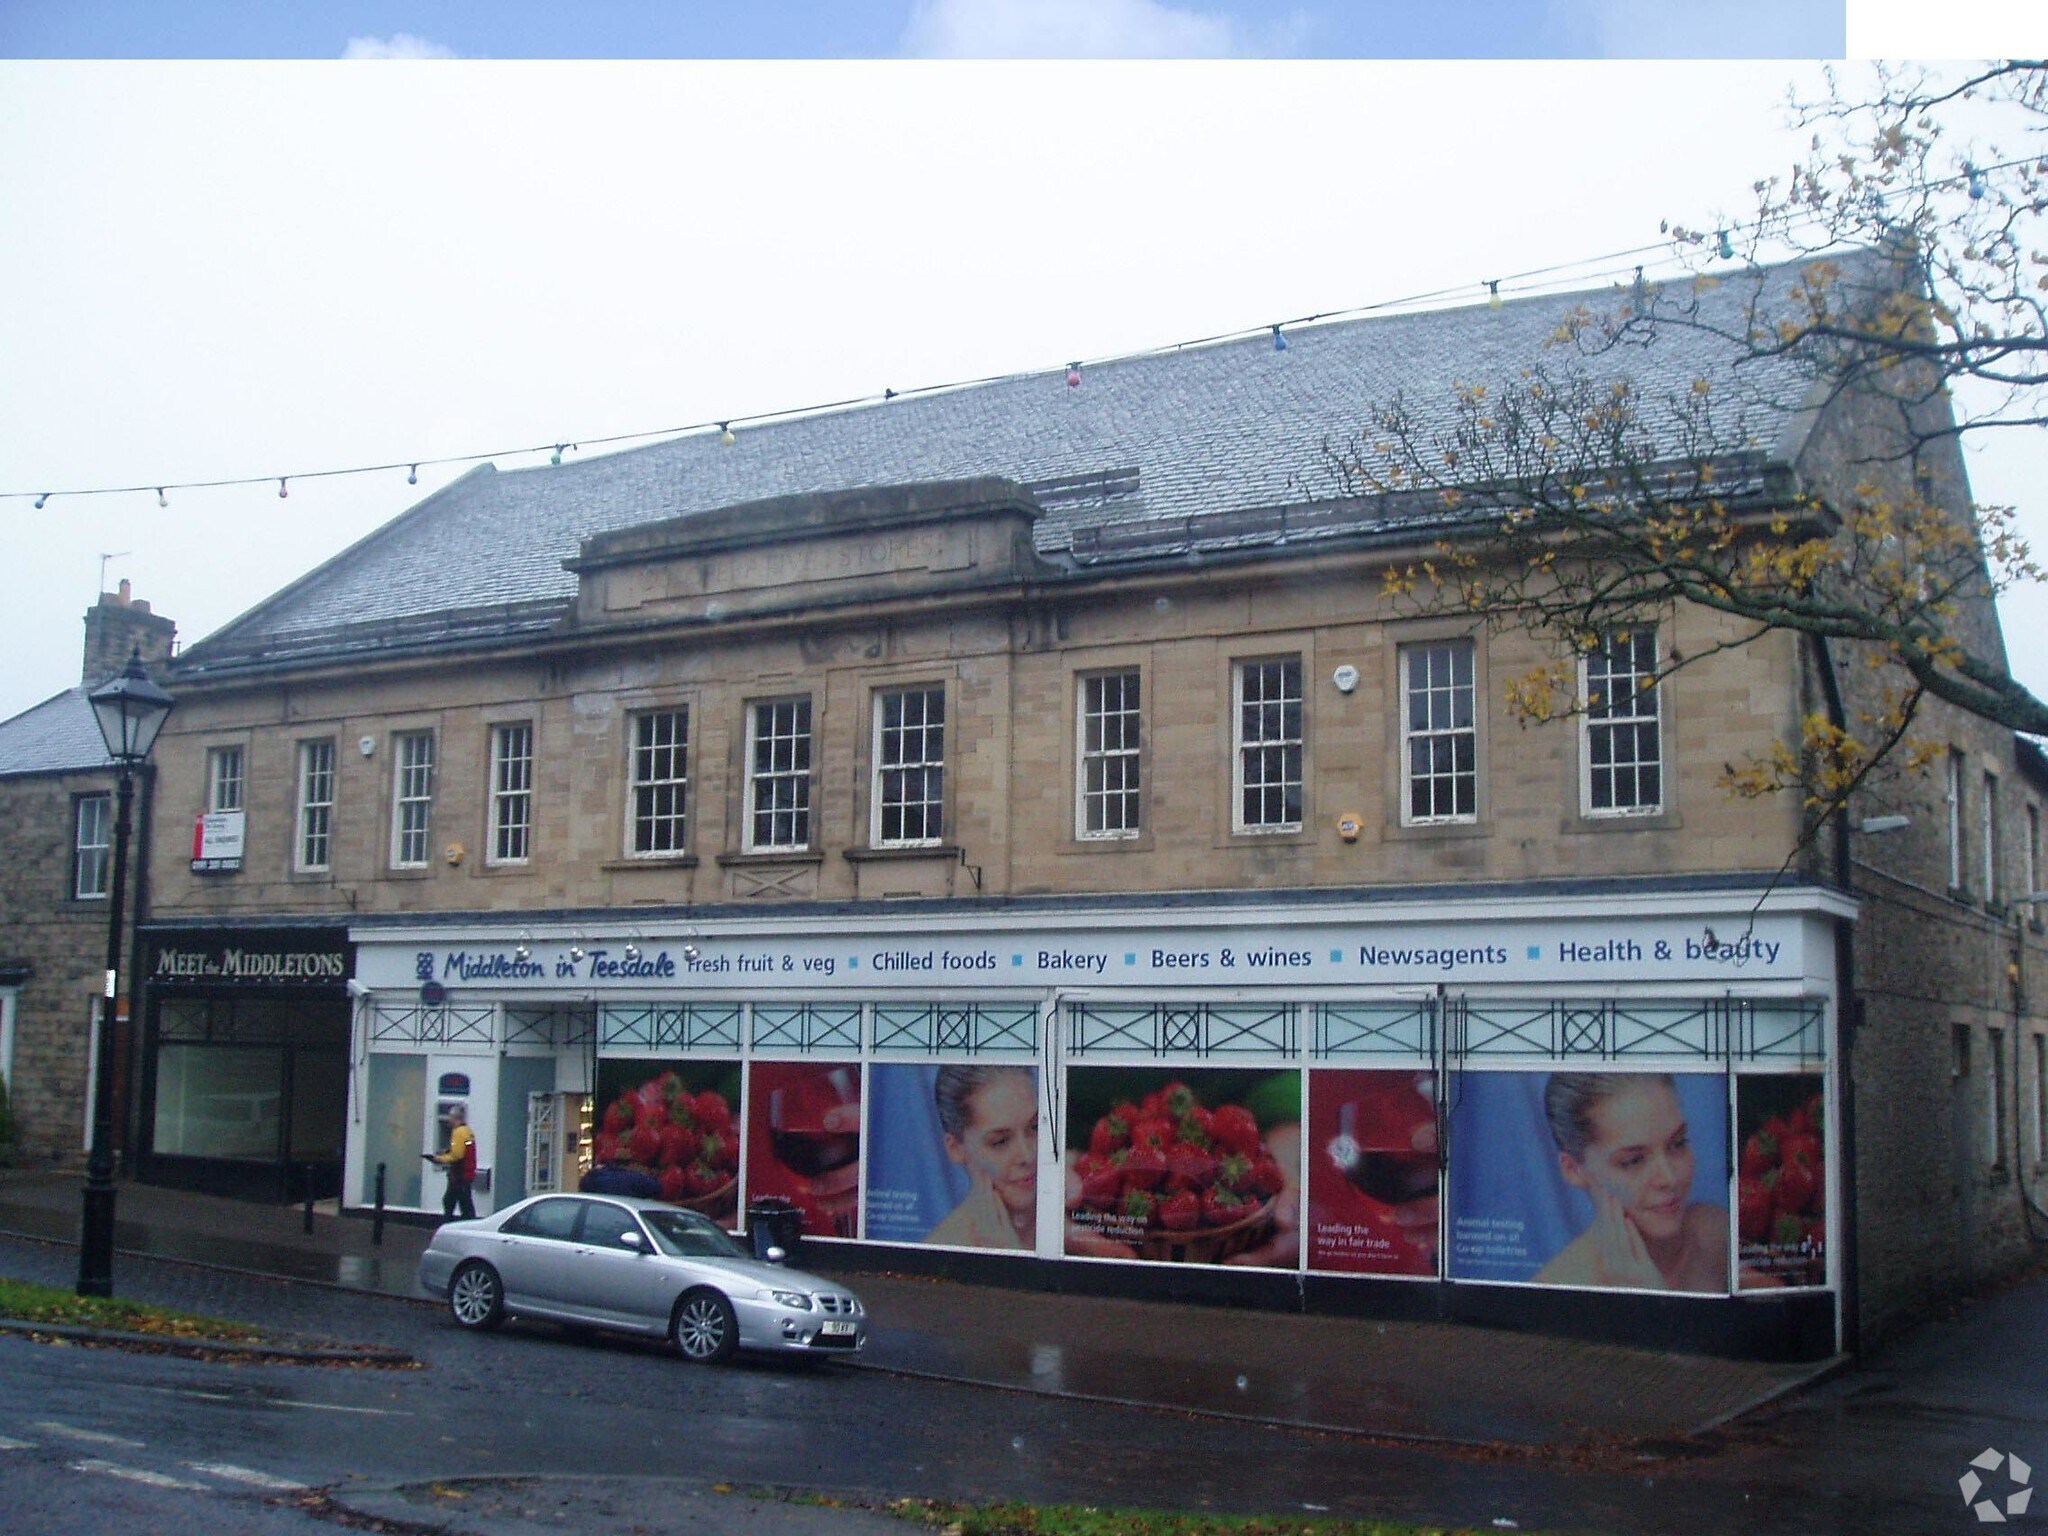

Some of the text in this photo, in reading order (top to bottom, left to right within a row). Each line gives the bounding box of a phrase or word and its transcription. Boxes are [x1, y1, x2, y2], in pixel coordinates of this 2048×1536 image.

[156, 949, 206, 975] MEET
[221, 948, 345, 976] MIDDLETONS
[872, 950, 997, 972] Chilled foods
[1037, 949, 1108, 974] Bakery
[1151, 946, 1312, 968] Beers & wines
[1359, 944, 1508, 970] Newsagents
[1559, 937, 1781, 966] Health & beauty
[444, 951, 544, 981] Middleton
[556, 953, 576, 978] in
[588, 950, 675, 979] Teesdale
[687, 952, 836, 976] Fresh fruit & veg
[1072, 1210, 1102, 1223] Leading
[1106, 1225, 1145, 1236] reduction
[1317, 1222, 1369, 1236] Leading the
[1318, 1236, 1391, 1250] way in fair trade
